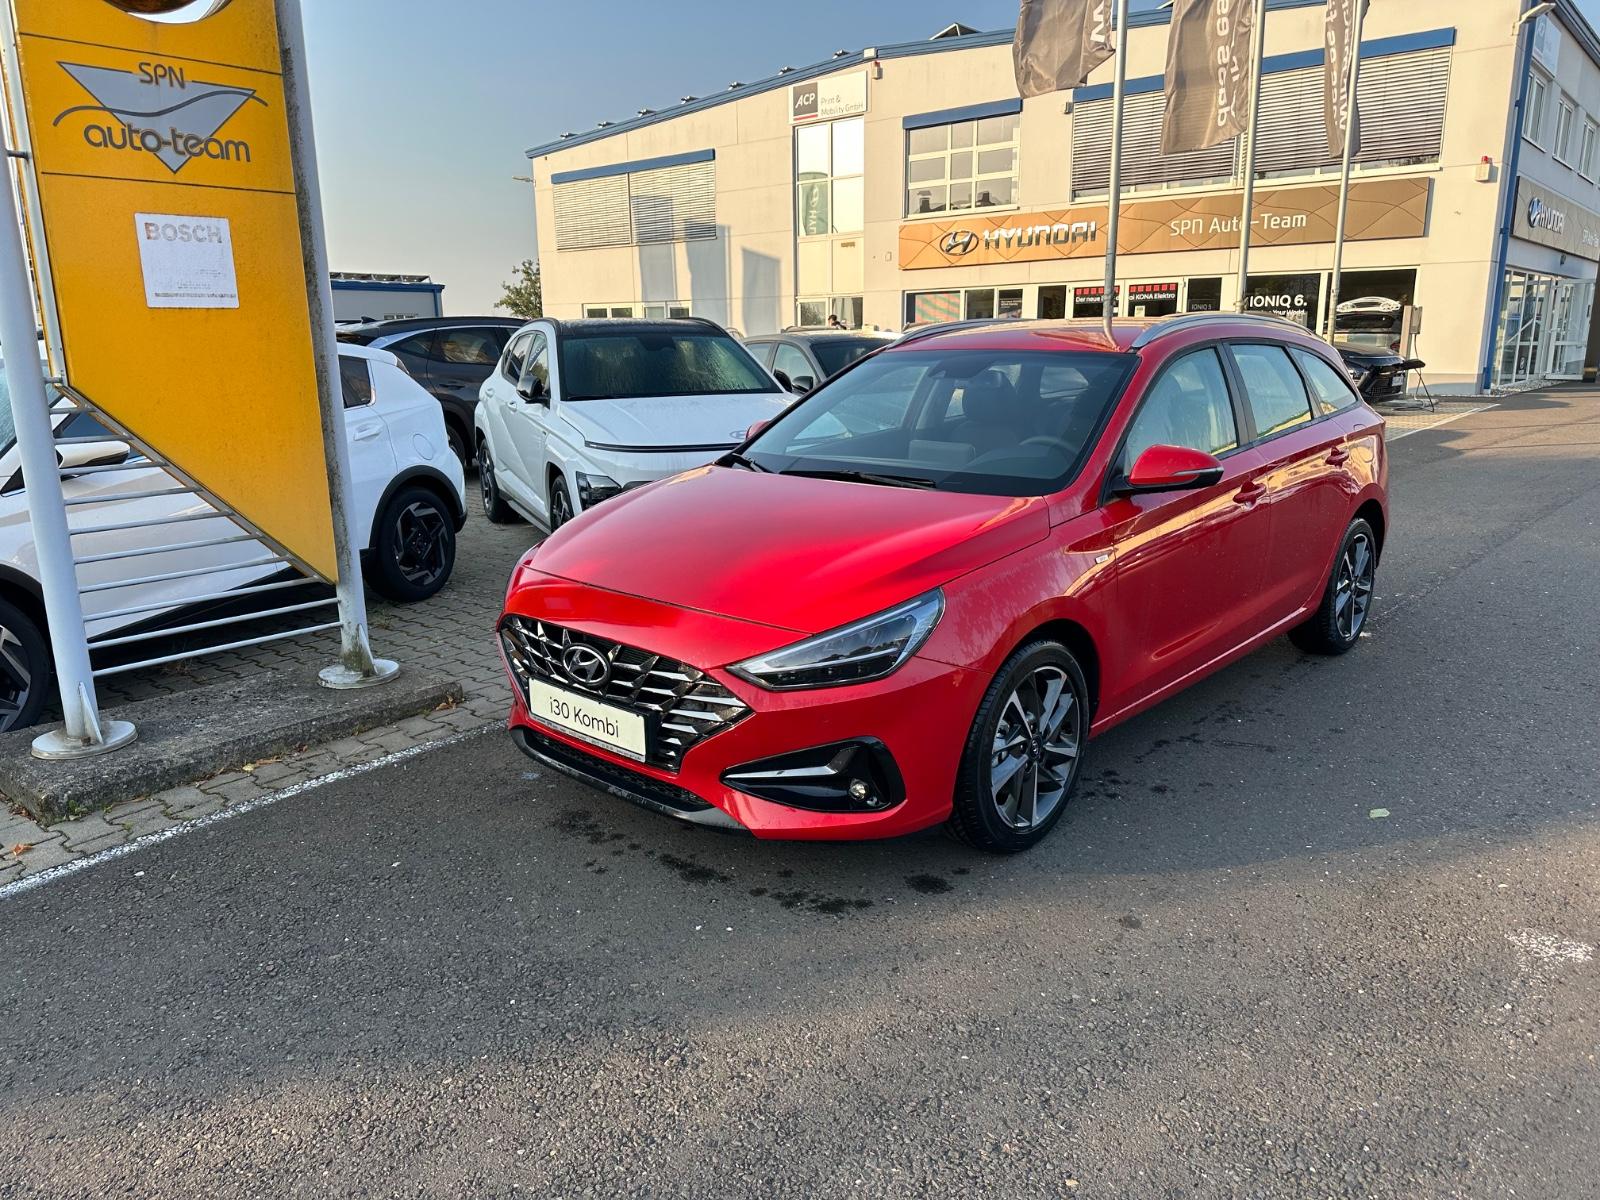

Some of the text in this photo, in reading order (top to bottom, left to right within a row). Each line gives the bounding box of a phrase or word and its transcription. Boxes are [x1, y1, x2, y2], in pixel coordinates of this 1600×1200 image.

[138, 62, 186, 89] SPN
[795, 92, 816, 109] ACP
[84, 122, 251, 163] auto-team
[144, 222, 223, 243] BOSCH
[983, 221, 1096, 249] HYUNDAI
[1170, 218, 1204, 237] SPN
[1249, 294, 1308, 308] IONIQ 6.
[549, 696, 570, 719] i30
[573, 706, 620, 738] Kombi
